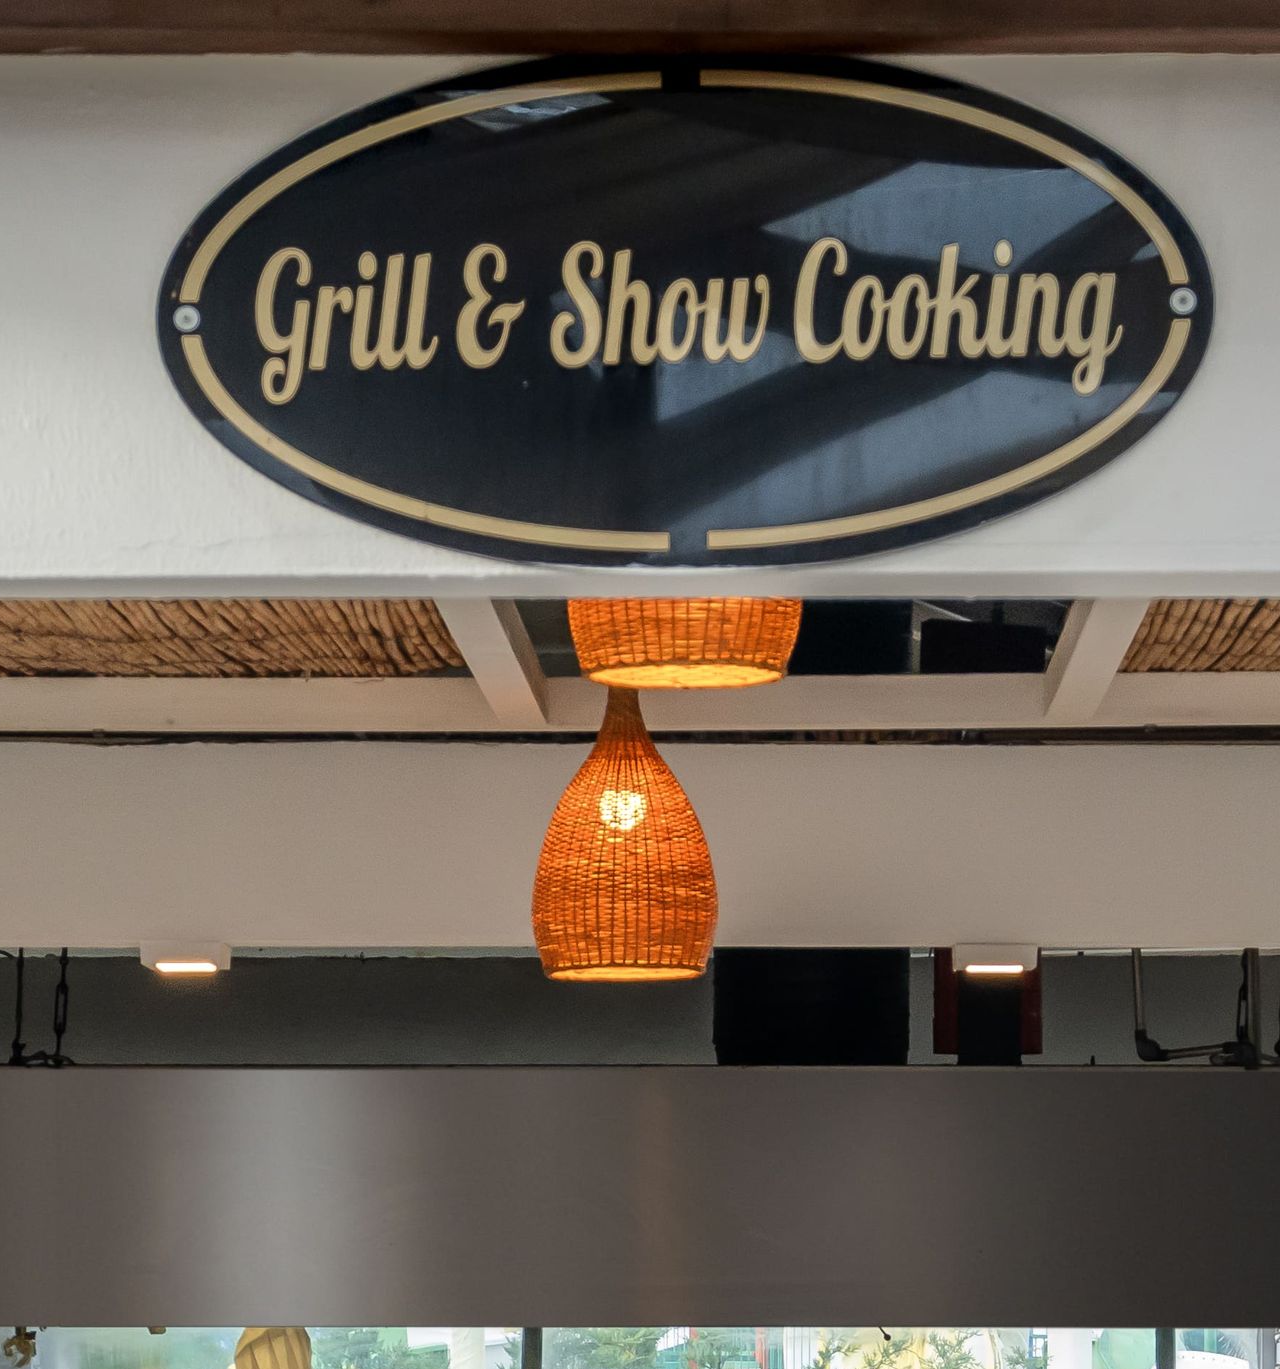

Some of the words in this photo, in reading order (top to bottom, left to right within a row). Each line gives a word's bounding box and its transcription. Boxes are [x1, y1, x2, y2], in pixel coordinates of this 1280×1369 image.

[254, 246, 438, 405] Grill
[455, 242, 524, 369] &
[548, 240, 770, 369] Show
[793, 236, 1122, 395] Cooking
